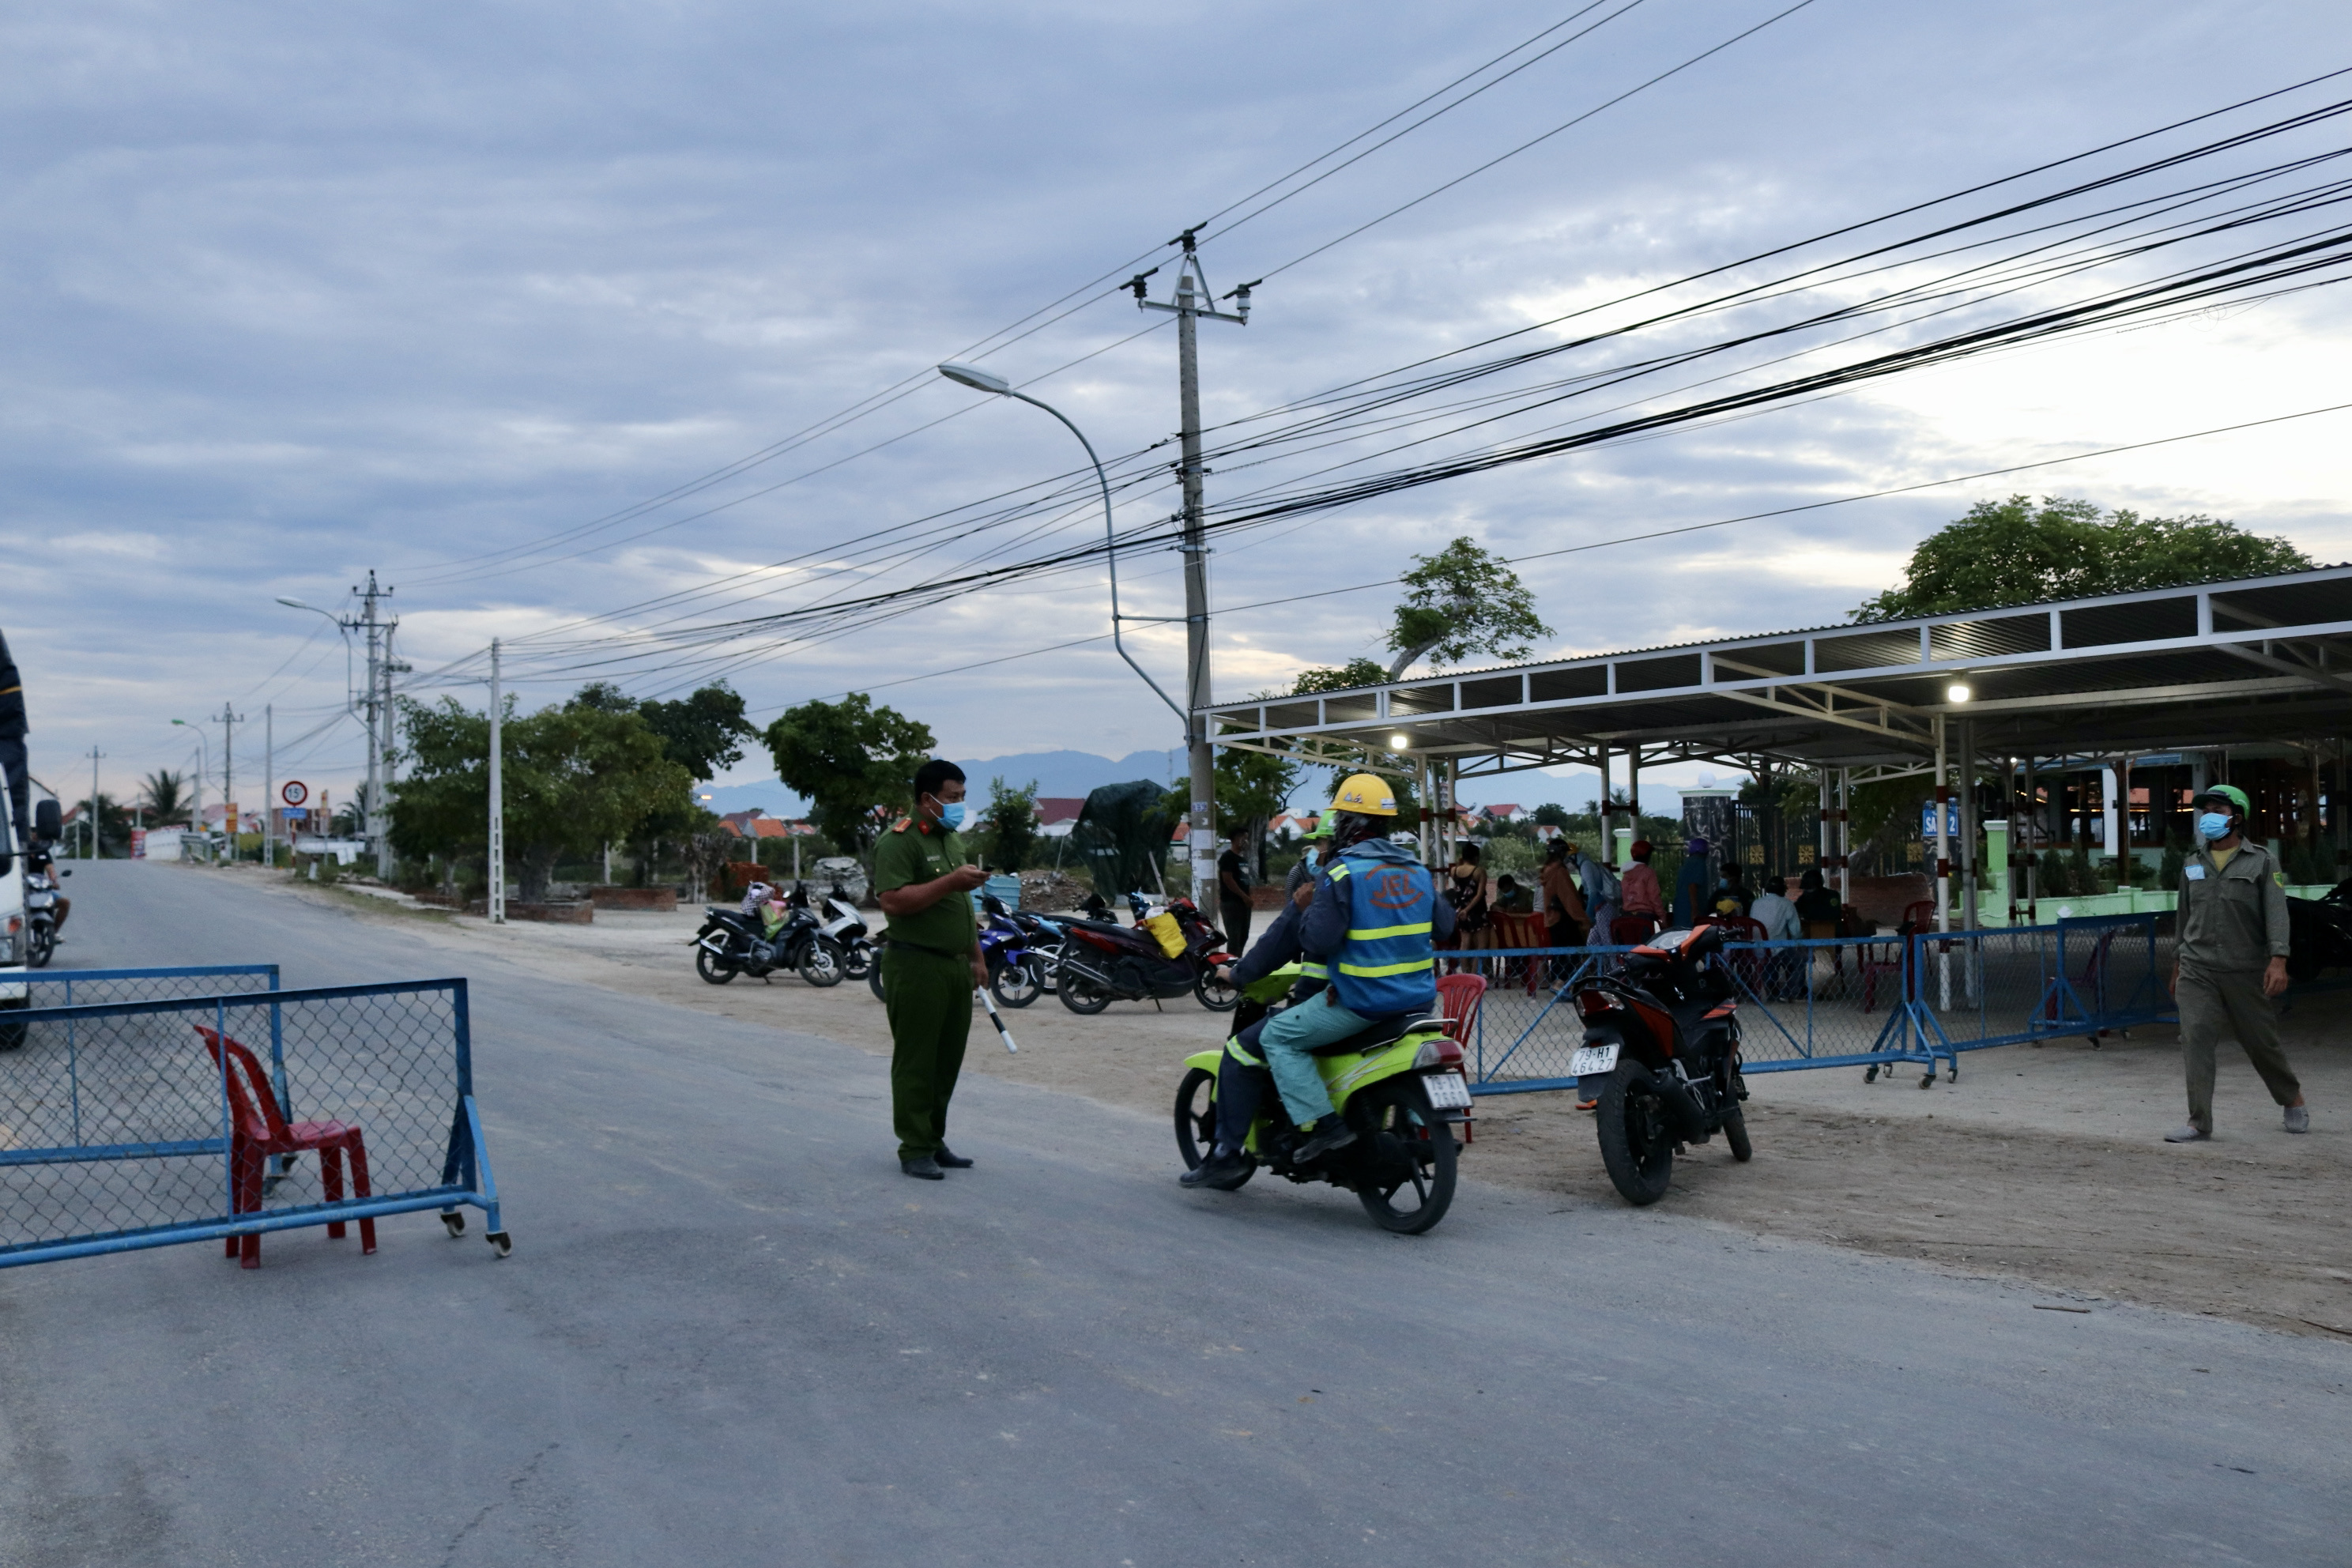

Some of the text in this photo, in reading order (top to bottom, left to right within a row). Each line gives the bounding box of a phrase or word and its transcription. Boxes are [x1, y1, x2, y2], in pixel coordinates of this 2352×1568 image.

[1949, 816, 1956, 832] 2
[1373, 873, 1416, 899] JEL
[1572, 1058, 1613, 1075] 464.27
